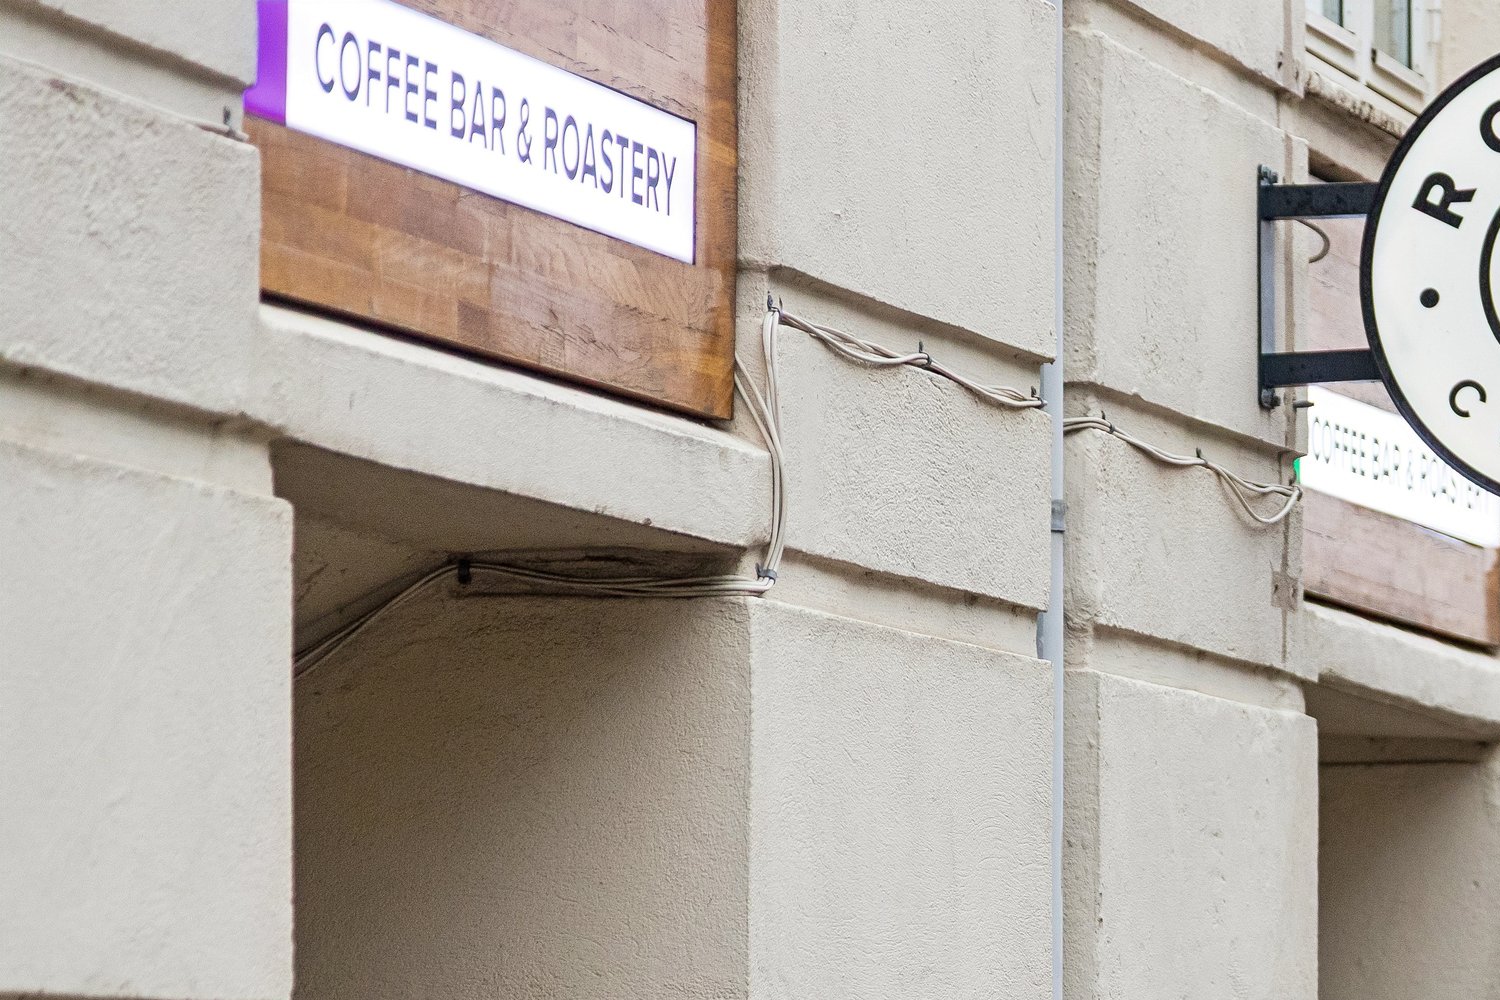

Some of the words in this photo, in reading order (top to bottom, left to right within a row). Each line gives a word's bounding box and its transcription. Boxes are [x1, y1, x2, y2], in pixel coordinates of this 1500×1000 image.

[315, 23, 438, 130] COFFEE
[450, 71, 506, 156] BAR
[516, 98, 533, 165] &
[544, 106, 677, 216] ROASTERY
[1311, 415, 1367, 477] COFFEE
[1372, 437, 1401, 488] BAR
